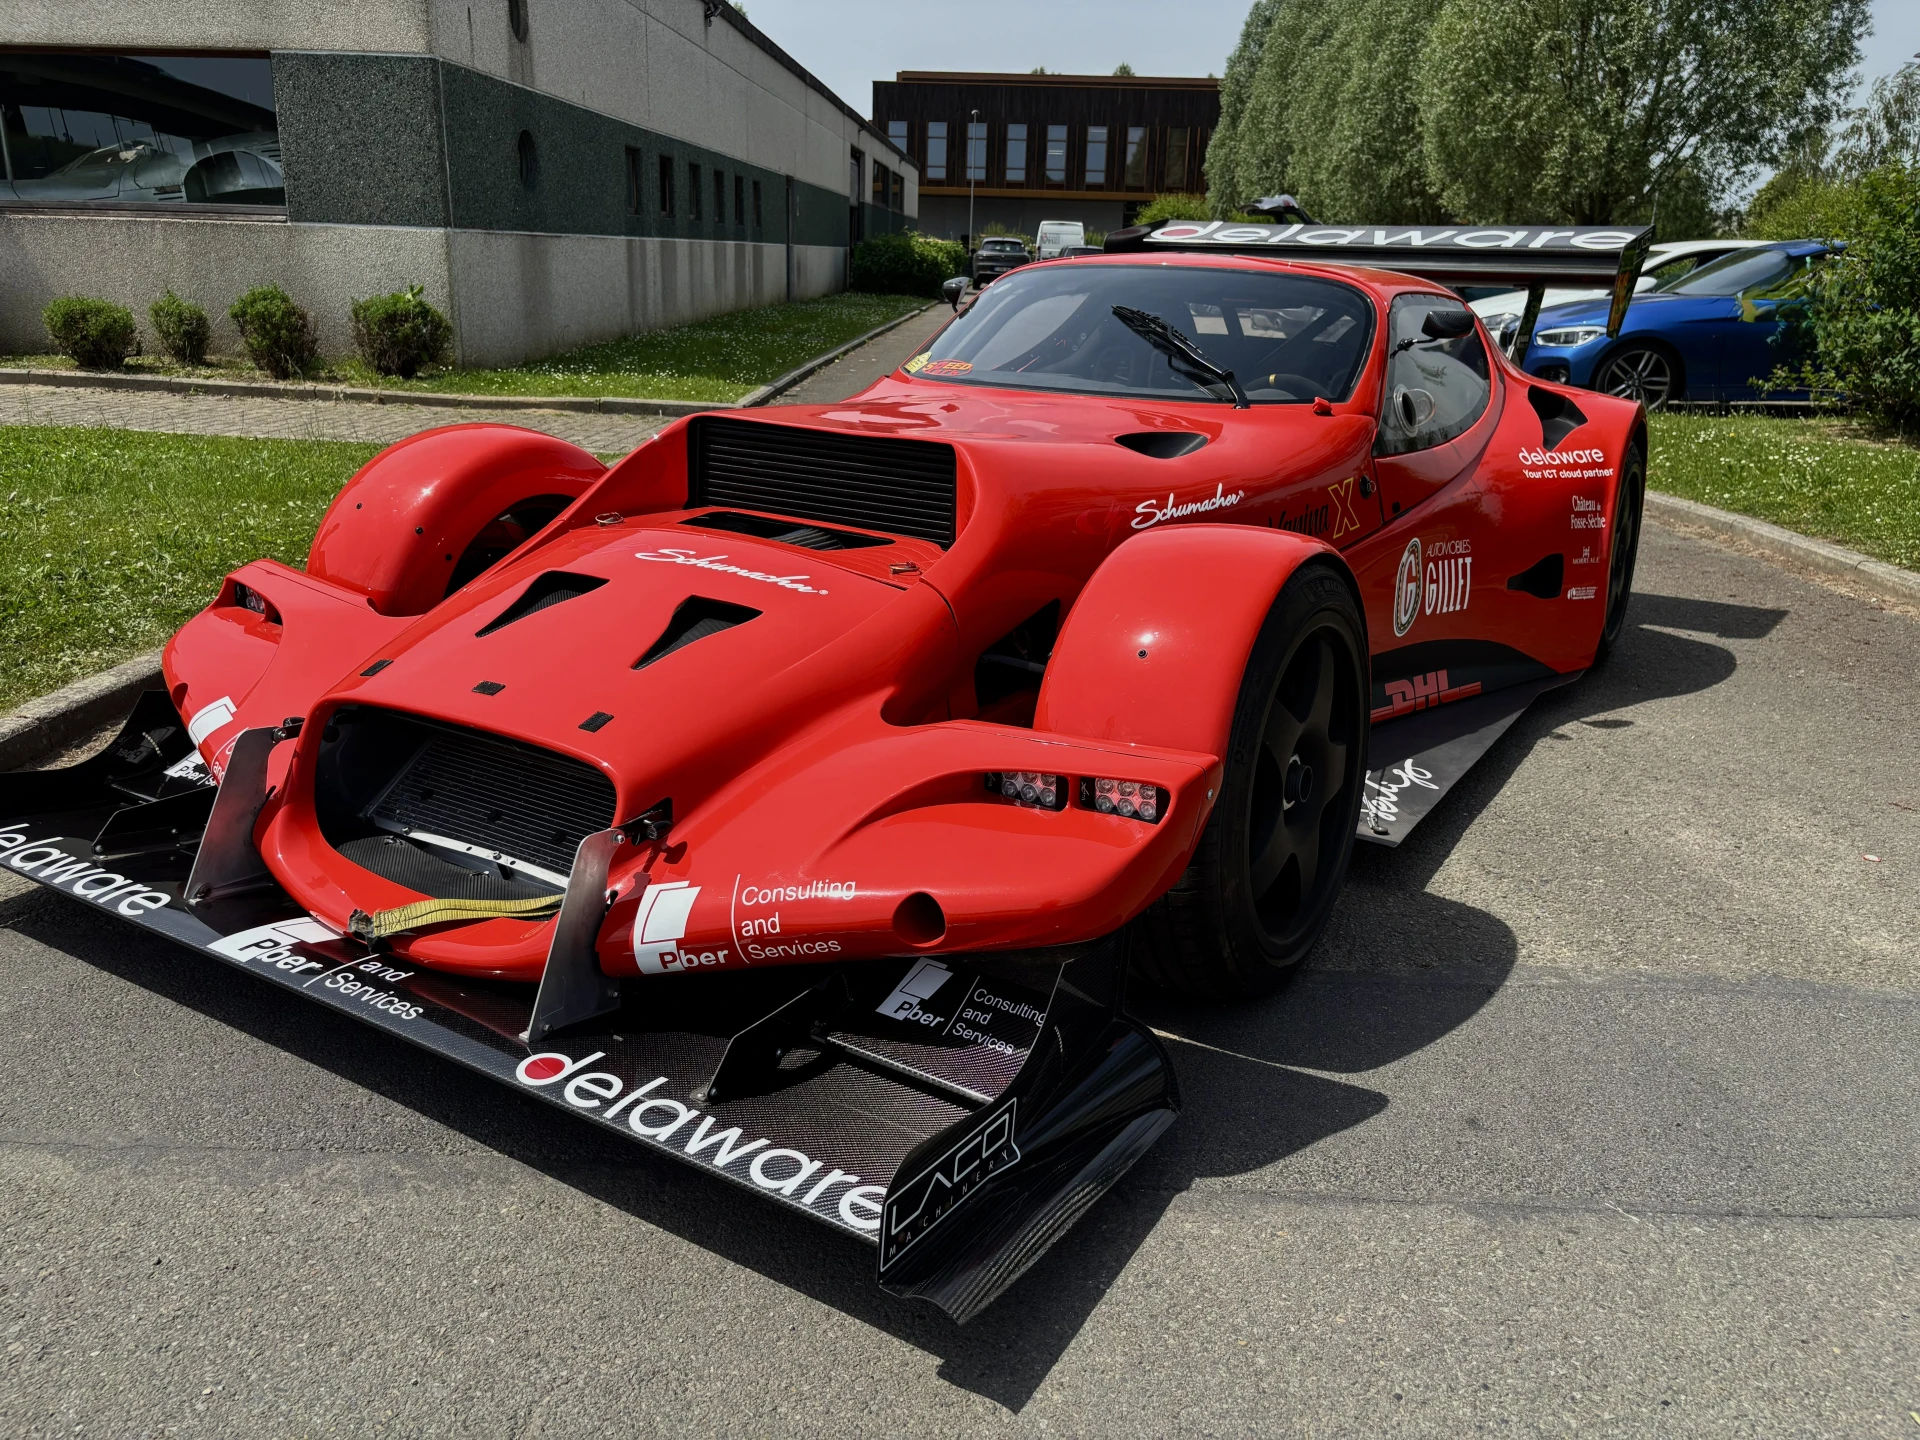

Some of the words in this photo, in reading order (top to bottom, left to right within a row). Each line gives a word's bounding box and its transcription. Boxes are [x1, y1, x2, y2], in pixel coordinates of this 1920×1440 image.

[1149, 221, 1637, 249] delaware
[1519, 447, 1604, 465] delaware
[1522, 469, 1541, 478] Your
[1543, 469, 1557, 478] ICT
[1559, 469, 1581, 479] cloud
[1583, 468, 1613, 479] partner
[1328, 477, 1360, 539] X
[1426, 539, 1471, 557] AUTOMOBILES
[1425, 557, 1472, 616] GILLET
[1384, 669, 1460, 717] DHL
[0, 823, 172, 916] laware
[741, 879, 856, 906] Consulting
[741, 912, 780, 937] and
[747, 939, 842, 960] Services
[358, 961, 415, 982] and
[324, 972, 424, 1020] Services
[973, 988, 1047, 1027] Consulting
[962, 1008, 992, 1025] and
[952, 1022, 1015, 1054] Services
[515, 1050, 887, 1229] delaware
[889, 1150, 1008, 1257] MACHINERY
